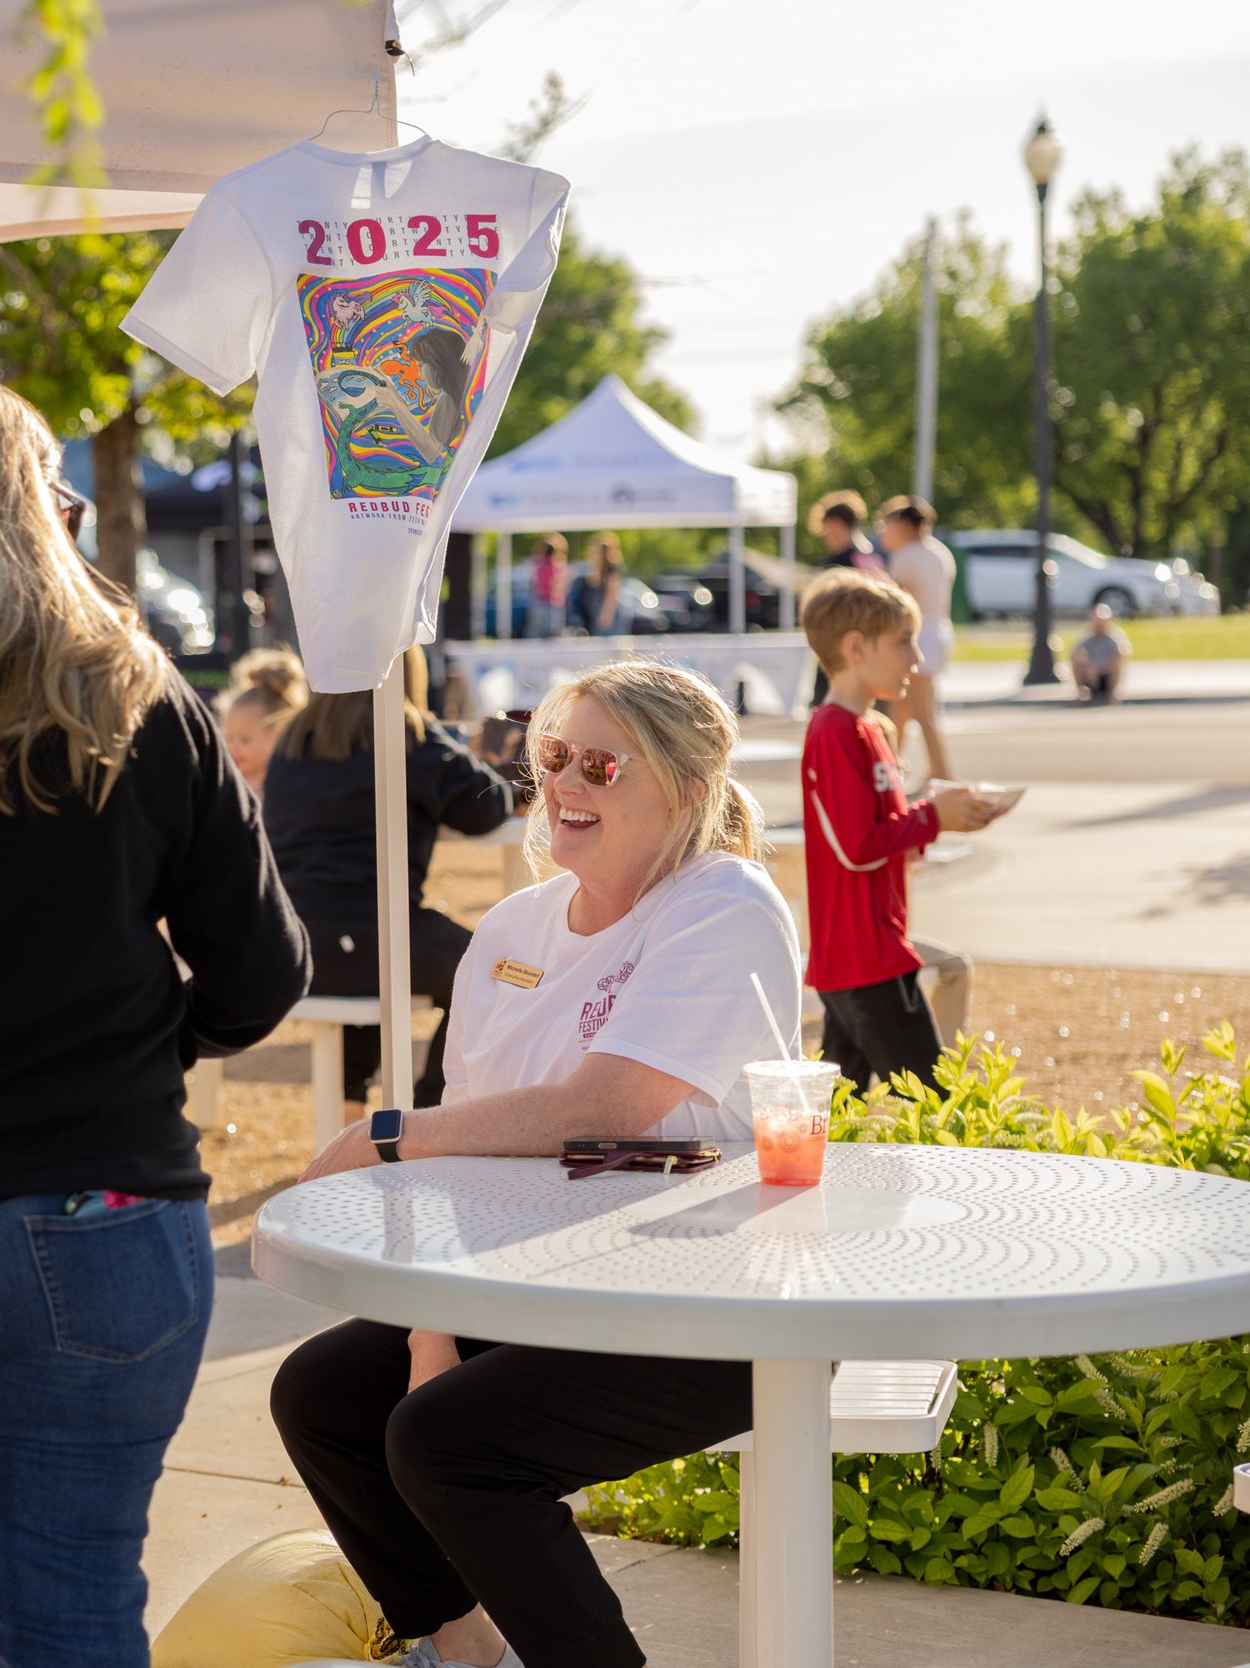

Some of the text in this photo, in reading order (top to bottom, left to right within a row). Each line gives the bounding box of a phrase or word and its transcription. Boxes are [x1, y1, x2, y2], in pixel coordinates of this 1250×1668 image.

[298, 214, 500, 266] 2025
[348, 500, 410, 514] REDBUD
[578, 1017, 608, 1034] FESTIV
